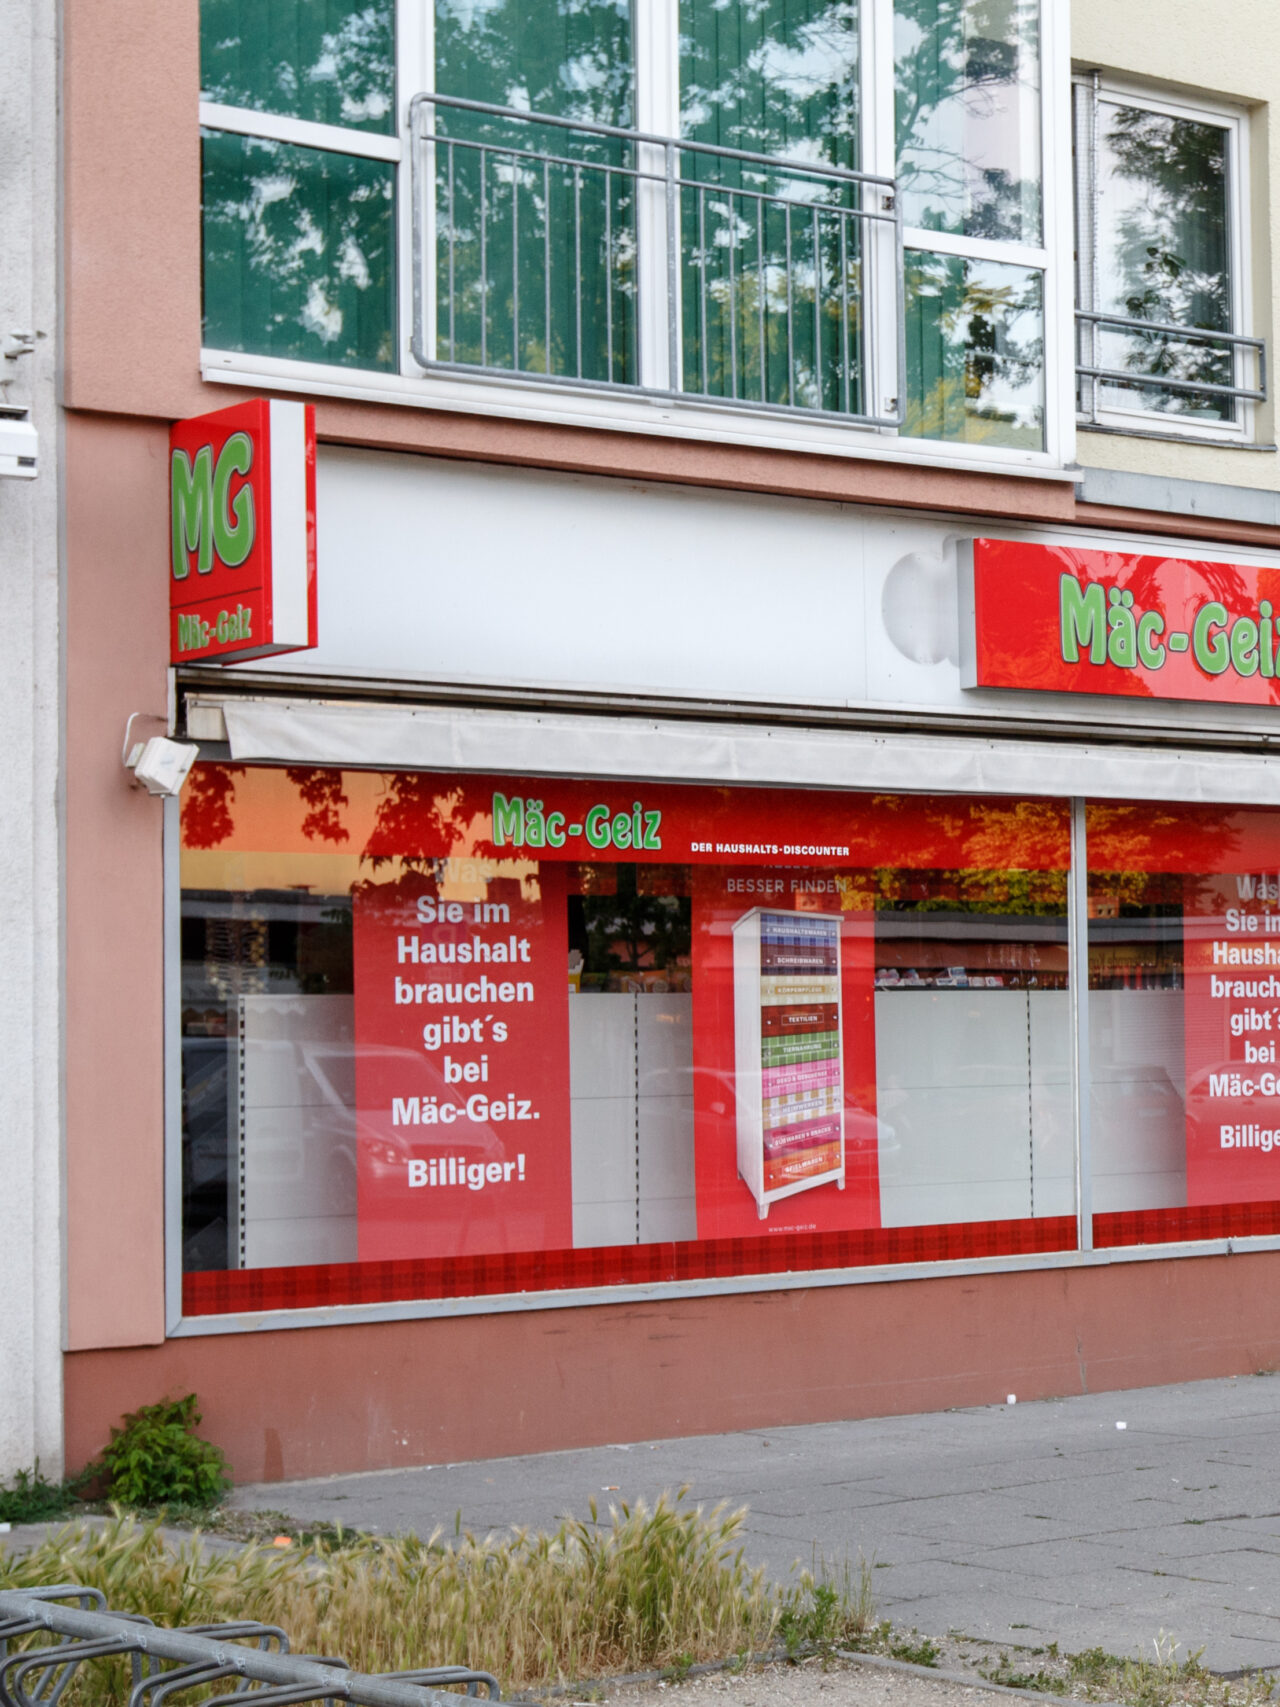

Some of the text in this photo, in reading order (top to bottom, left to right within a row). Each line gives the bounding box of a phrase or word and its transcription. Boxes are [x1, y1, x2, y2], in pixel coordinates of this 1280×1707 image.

[171, 431, 254, 579] MG
[178, 604, 251, 652] Mäc-Geiz
[493, 792, 661, 850] Mäc-Geiz
[691, 842, 713, 852] DER
[727, 878, 847, 894] BESSER FINDEN
[1236, 877, 1279, 900] Was
[417, 895, 510, 923] Sie im
[1225, 910, 1258, 932] Sie
[397, 936, 531, 964] Haushalt
[394, 976, 534, 1005] brauchen
[1244, 1041, 1276, 1063] bei
[443, 1054, 489, 1084] bei
[391, 1094, 540, 1126] Mäc-Geiz.
[407, 1154, 526, 1191] Billiger!
